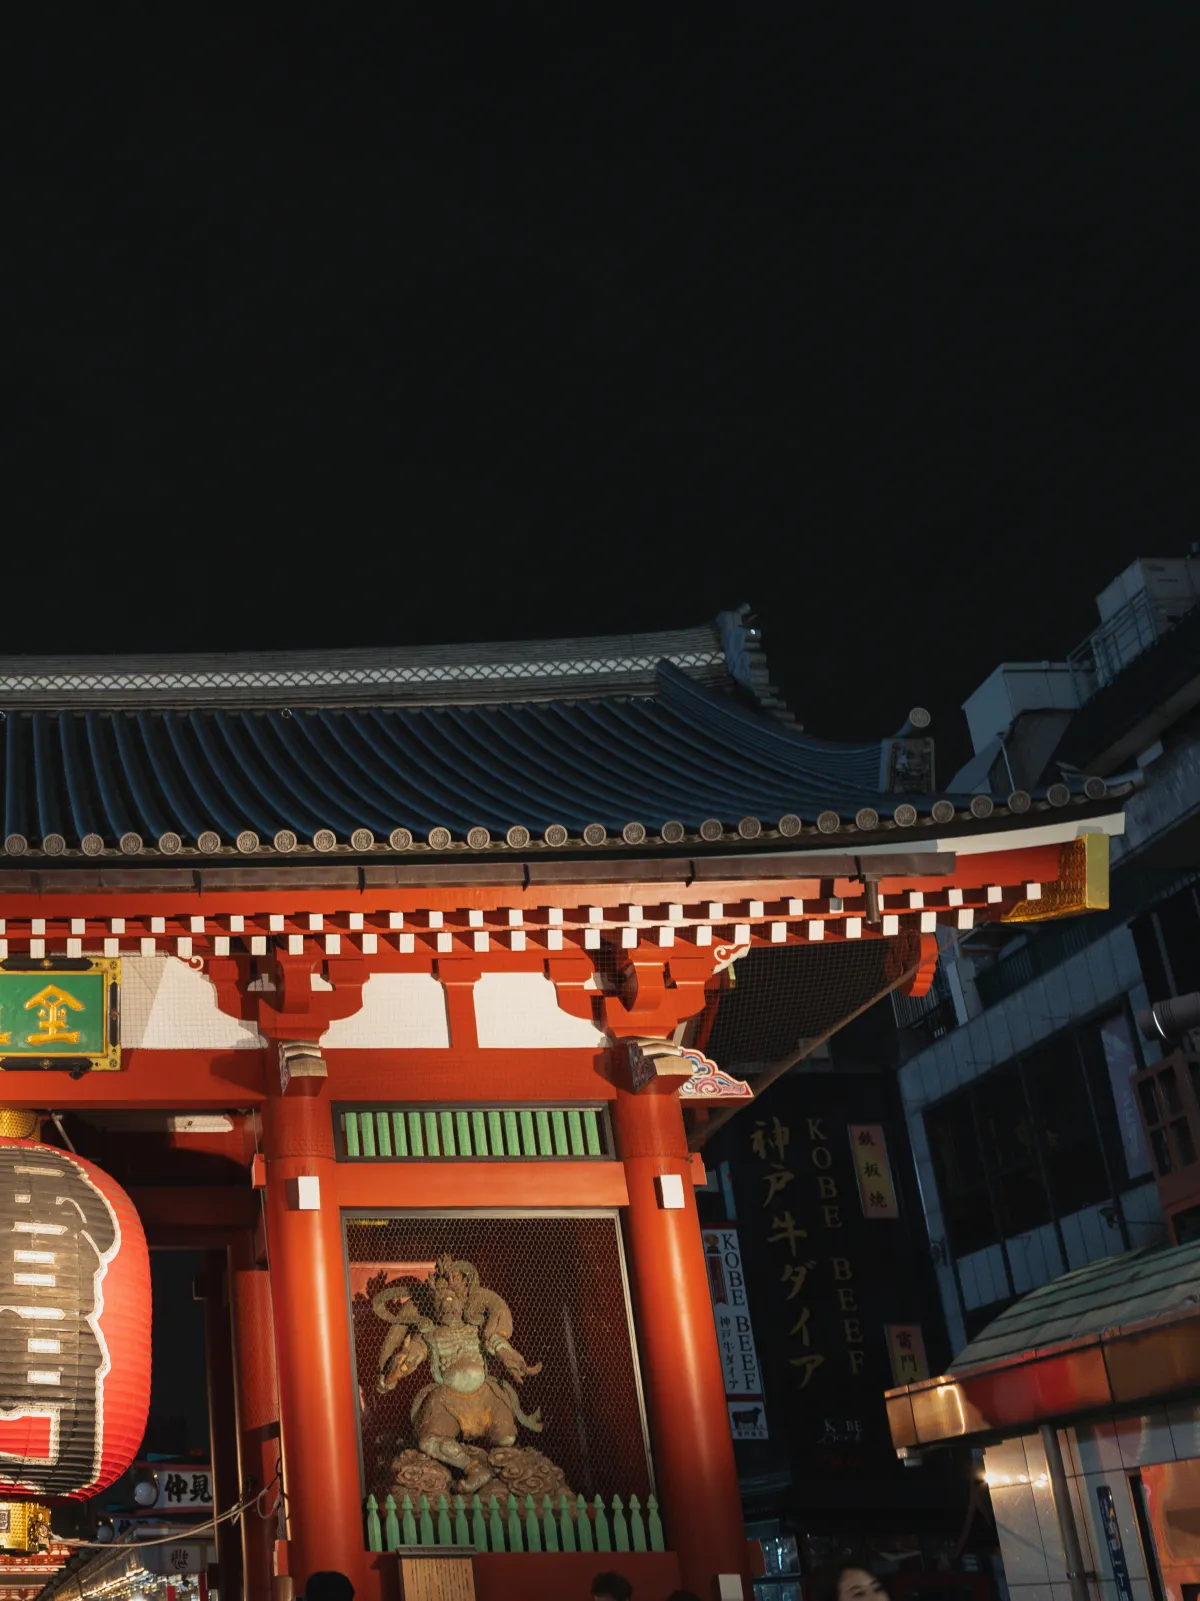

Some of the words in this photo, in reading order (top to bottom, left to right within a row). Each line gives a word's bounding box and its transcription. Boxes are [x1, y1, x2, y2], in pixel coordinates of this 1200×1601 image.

[721, 1233, 745, 1306] KOBE
[735, 1315, 755, 1390] BEEF
[806, 1117, 842, 1228] KOBE
[830, 1257, 866, 1374] BEEF
[895, 1331, 918, 1384] 雷門
